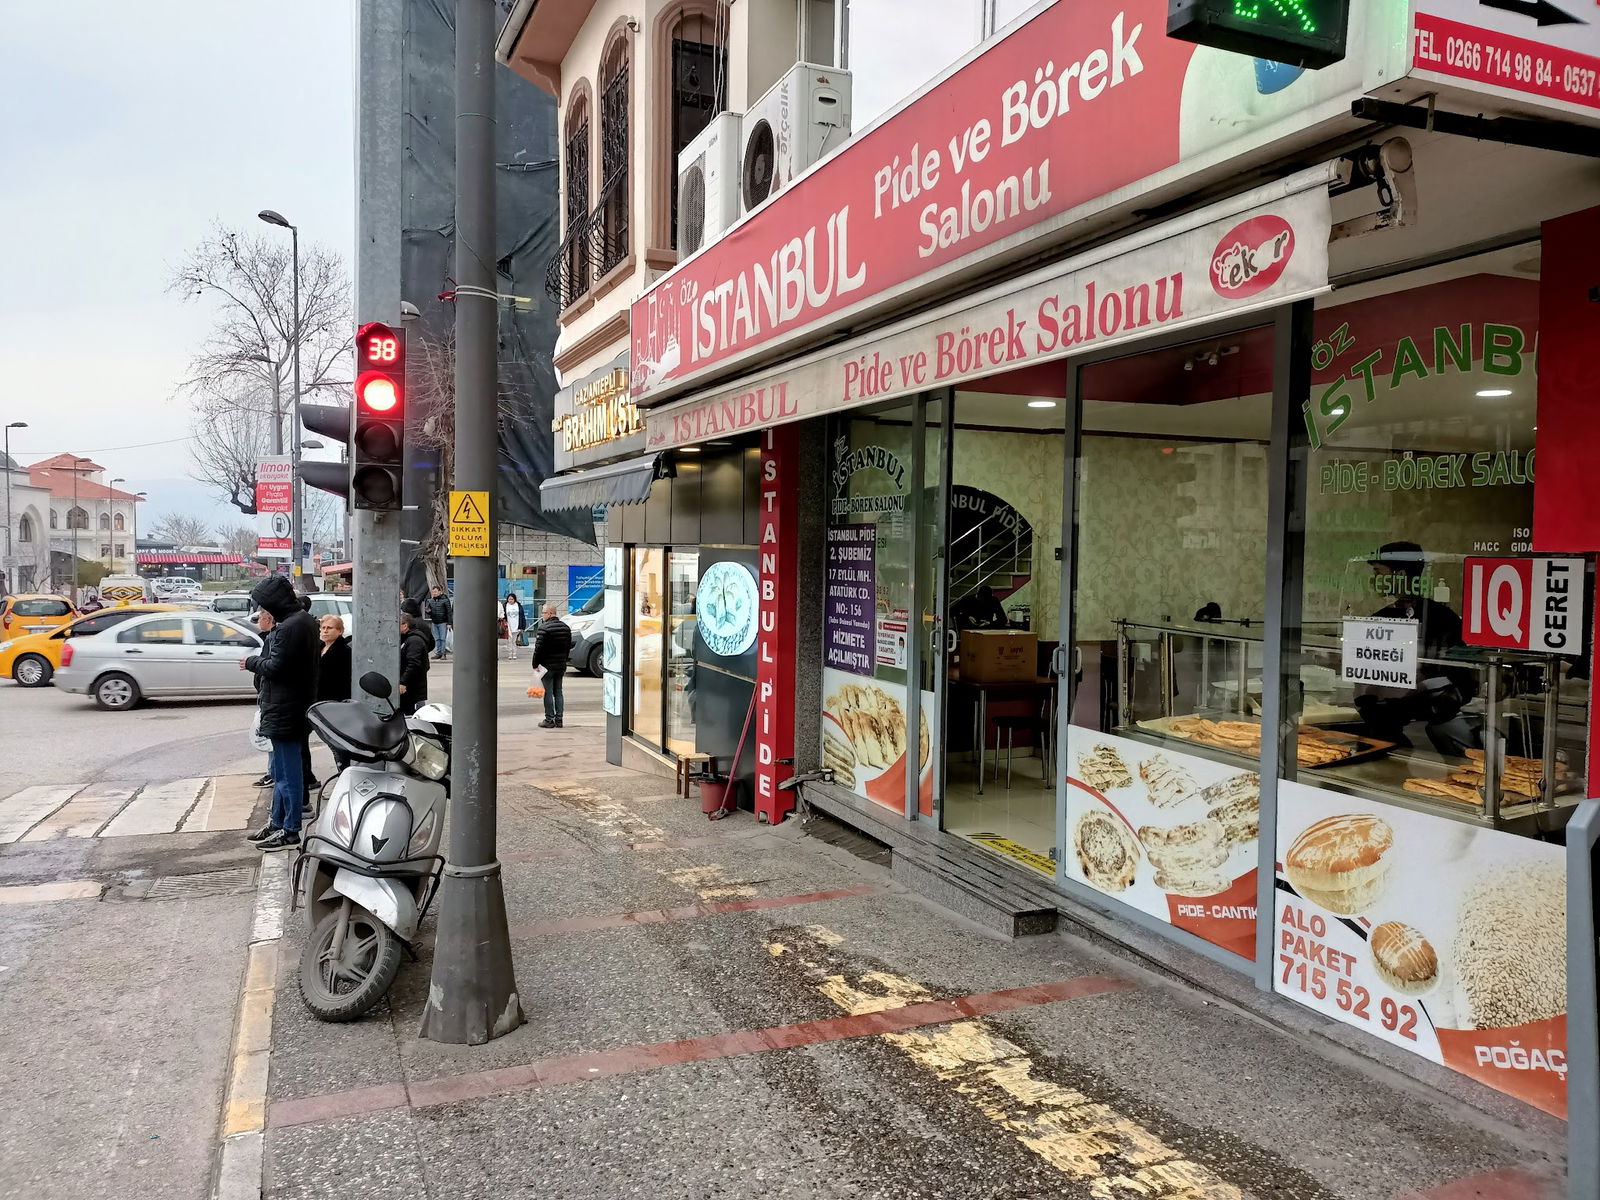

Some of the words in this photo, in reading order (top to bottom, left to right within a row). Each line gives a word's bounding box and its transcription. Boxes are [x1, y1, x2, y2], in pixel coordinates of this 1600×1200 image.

[1413, 28, 1442, 63] TEL.
[1446, 36, 1481, 72] 0266
[1485, 45, 1511, 78] 714
[1514, 52, 1532, 83] 98
[1535, 57, 1552, 87] 84
[1563, 64, 1596, 97] 0537
[780, 82, 790, 156] arçelik
[874, 142, 941, 219] Pide
[948, 118, 991, 175] ve
[1001, 10, 1144, 148] Börek
[918, 158, 1052, 259] Salonu
[690, 204, 867, 364] İSTANBUL
[368, 337, 396, 361] 38
[843, 350, 893, 402] Pide
[899, 349, 927, 388] ve
[934, 308, 1027, 380] Börek
[1036, 271, 1184, 355] Salonu
[1311, 321, 1356, 371] ÖZ
[1302, 322, 1539, 452] İSTANB
[1320, 457, 1368, 495] PİDE
[1383, 451, 1466, 491] BÖREK
[269, 484, 289, 492] Uygun
[874, 493, 906, 513] SALONU
[827, 527, 858, 542] İSTANBUL
[859, 526, 875, 542] PİDE
[1474, 541, 1500, 552] HACC
[1511, 542, 1533, 552] GIDA
[1513, 527, 1530, 538] ISO
[830, 548, 837, 560] 2.
[838, 546, 872, 564] ŞUBEMİZ
[828, 568, 836, 580] 17
[838, 566, 856, 581] EYLÜL
[857, 570, 872, 582] MH.
[829, 584, 857, 600] ATATÜRK
[858, 587, 870, 600] CD.
[1470, 564, 1524, 644] IQ
[1543, 560, 1570, 649] CERET
[835, 602, 848, 614] NO:
[850, 604, 862, 617] 156
[832, 628, 866, 649] HİZMETE
[1365, 626, 1394, 641] KÜT
[828, 648, 870, 670] AÇILMIŞTIR
[1355, 646, 1404, 663] BÖREĞİ
[1345, 666, 1412, 685] BULUNUR.
[759, 681, 773, 798] PİDE
[1281, 904, 1326, 938] ALO
[1281, 929, 1357, 977] PAKET
[1279, 953, 1327, 1000] 715
[1335, 977, 1370, 1021] 52
[1380, 996, 1418, 1042] 92
[1474, 1039, 1568, 1081] POĞAÇ
